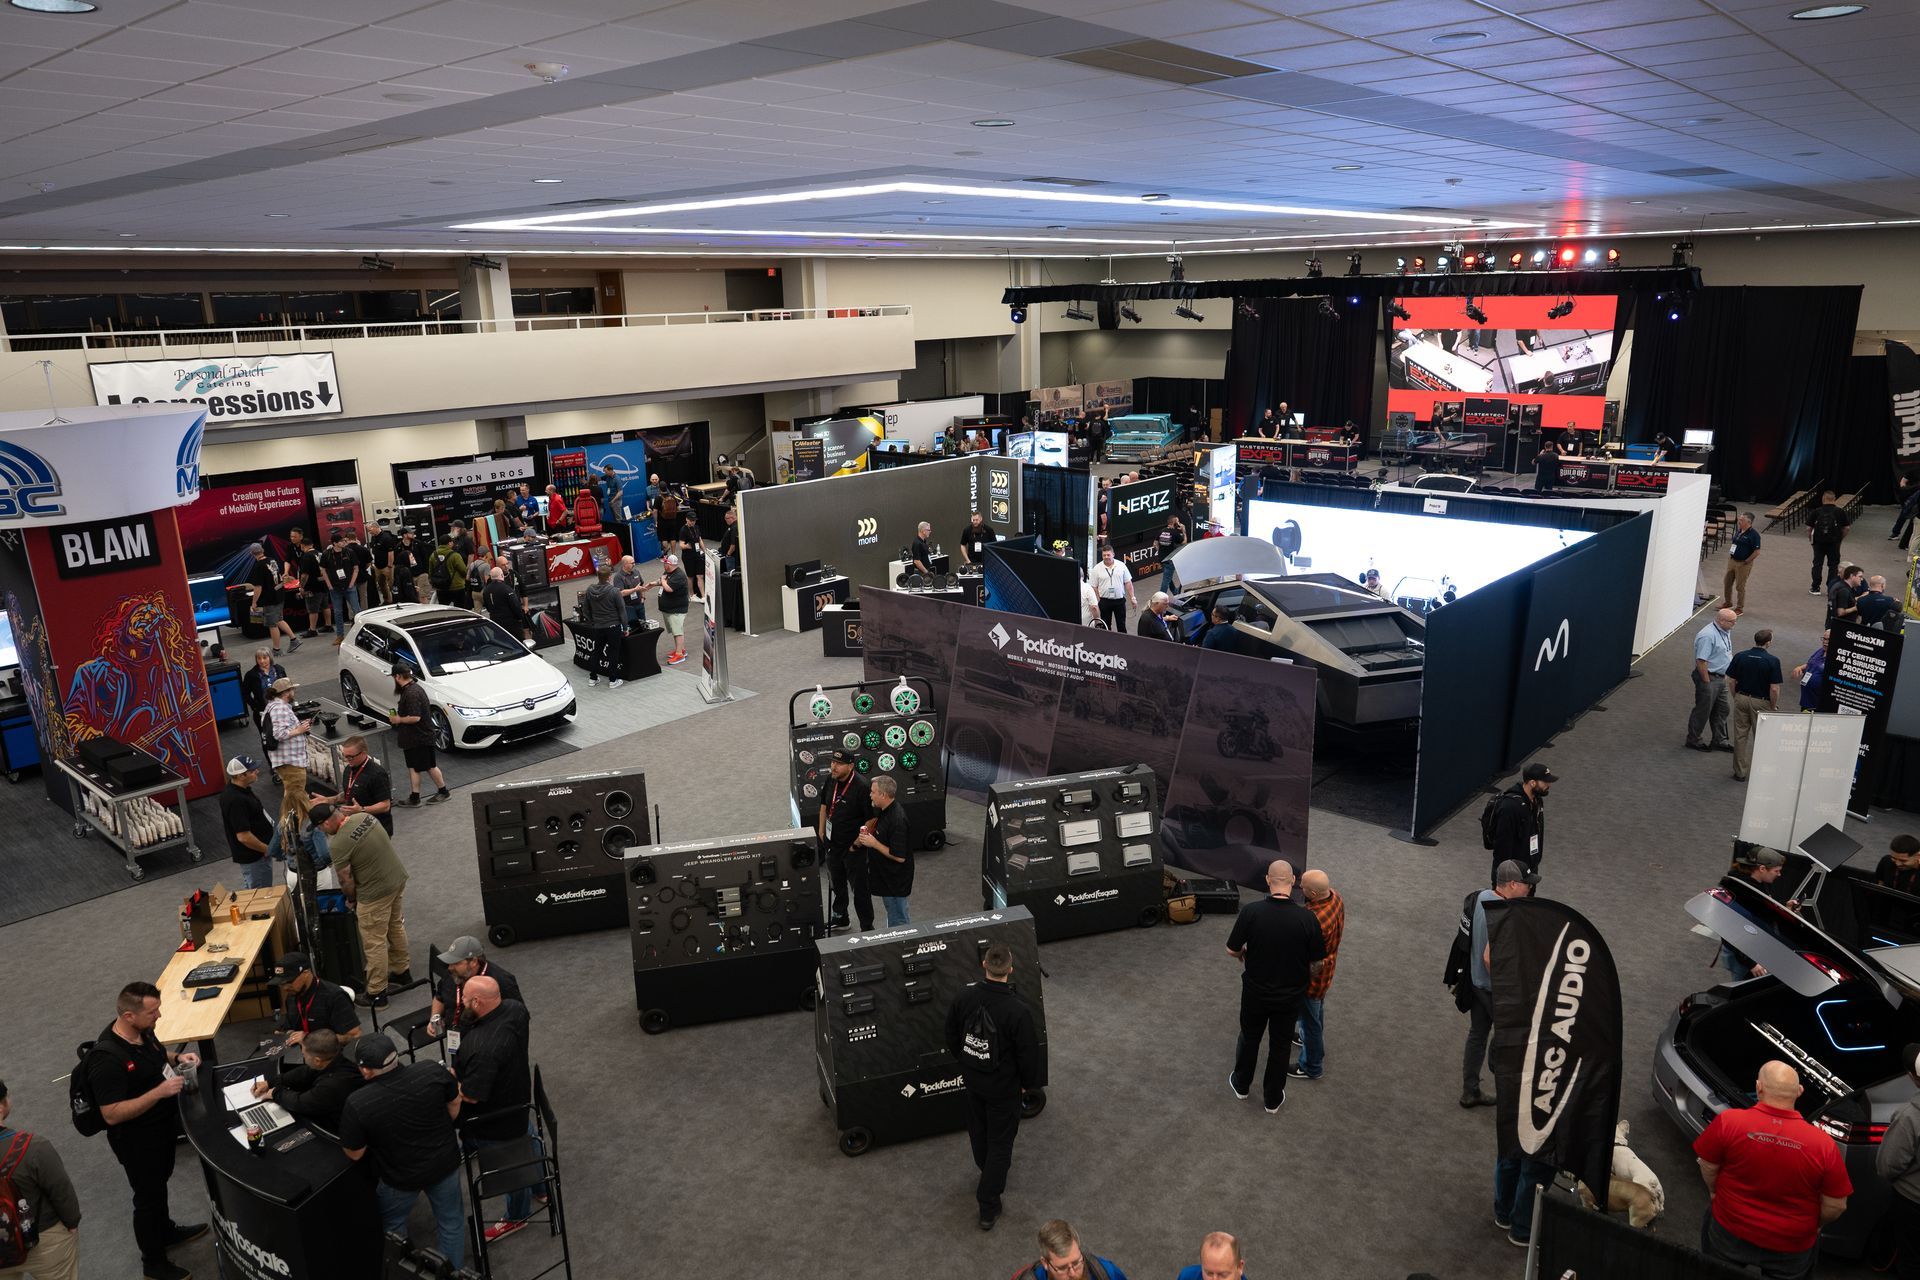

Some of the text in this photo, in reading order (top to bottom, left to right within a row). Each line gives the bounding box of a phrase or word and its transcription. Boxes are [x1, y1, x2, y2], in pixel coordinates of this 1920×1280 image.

[174, 363, 265, 382] Personal Touch
[1409, 361, 1452, 390] MASTERTECH
[197, 380, 251, 389] Catering
[1465, 416, 1506, 425] EXPO
[1240, 450, 1282, 460] EXPO
[421, 468, 524, 488] KEYSTON BROS
[1559, 468, 1588, 479] BUILD OFF
[1617, 474, 1669, 486] EXP
[232, 486, 300, 503] Creating the Future
[991, 487, 1008, 495] morel
[219, 498, 301, 516] of Mobility Experiences
[1118, 489, 1170, 515] HERTZ
[62, 523, 150, 568] BLAM
[858, 534, 878, 545] morel
[1846, 631, 1885, 647] SiriusXM
[1016, 628, 1128, 670] Rockford Fosgate
[1837, 648, 1887, 667] GET CERTIFIED
[1007, 653, 1116, 682] MOBILE MARINE MOTORSPORTS MOTORCYCLE
[1035, 666, 1085, 681] PURPOSE BUILT AUDIO
[1842, 663, 1876, 678] PRODUCT
[1852, 659, 1885, 674] SIRIUSXM
[1838, 669, 1878, 686] SPECIALIST
[796, 734, 834, 743] SPEAKERS
[548, 788, 573, 797] AUDIO
[1000, 798, 1047, 810] AMPLIFIERS
[700, 857, 732, 865] WRANGLER
[551, 888, 606, 902] Rockford Fosgate
[1068, 889, 1119, 903] Rockford Fosgate
[916, 943, 947, 955] AUDIO
[918, 940, 944, 948] MOBILE
[848, 1025, 876, 1033] POWER
[1534, 939, 1591, 1115] ARC AUDIO
[849, 1033, 877, 1042] SERIES
[920, 1078, 957, 1094] Rockford
[1758, 1134, 1802, 1149] ARC AUDIO
[230, 1222, 290, 1276] Fosgate
